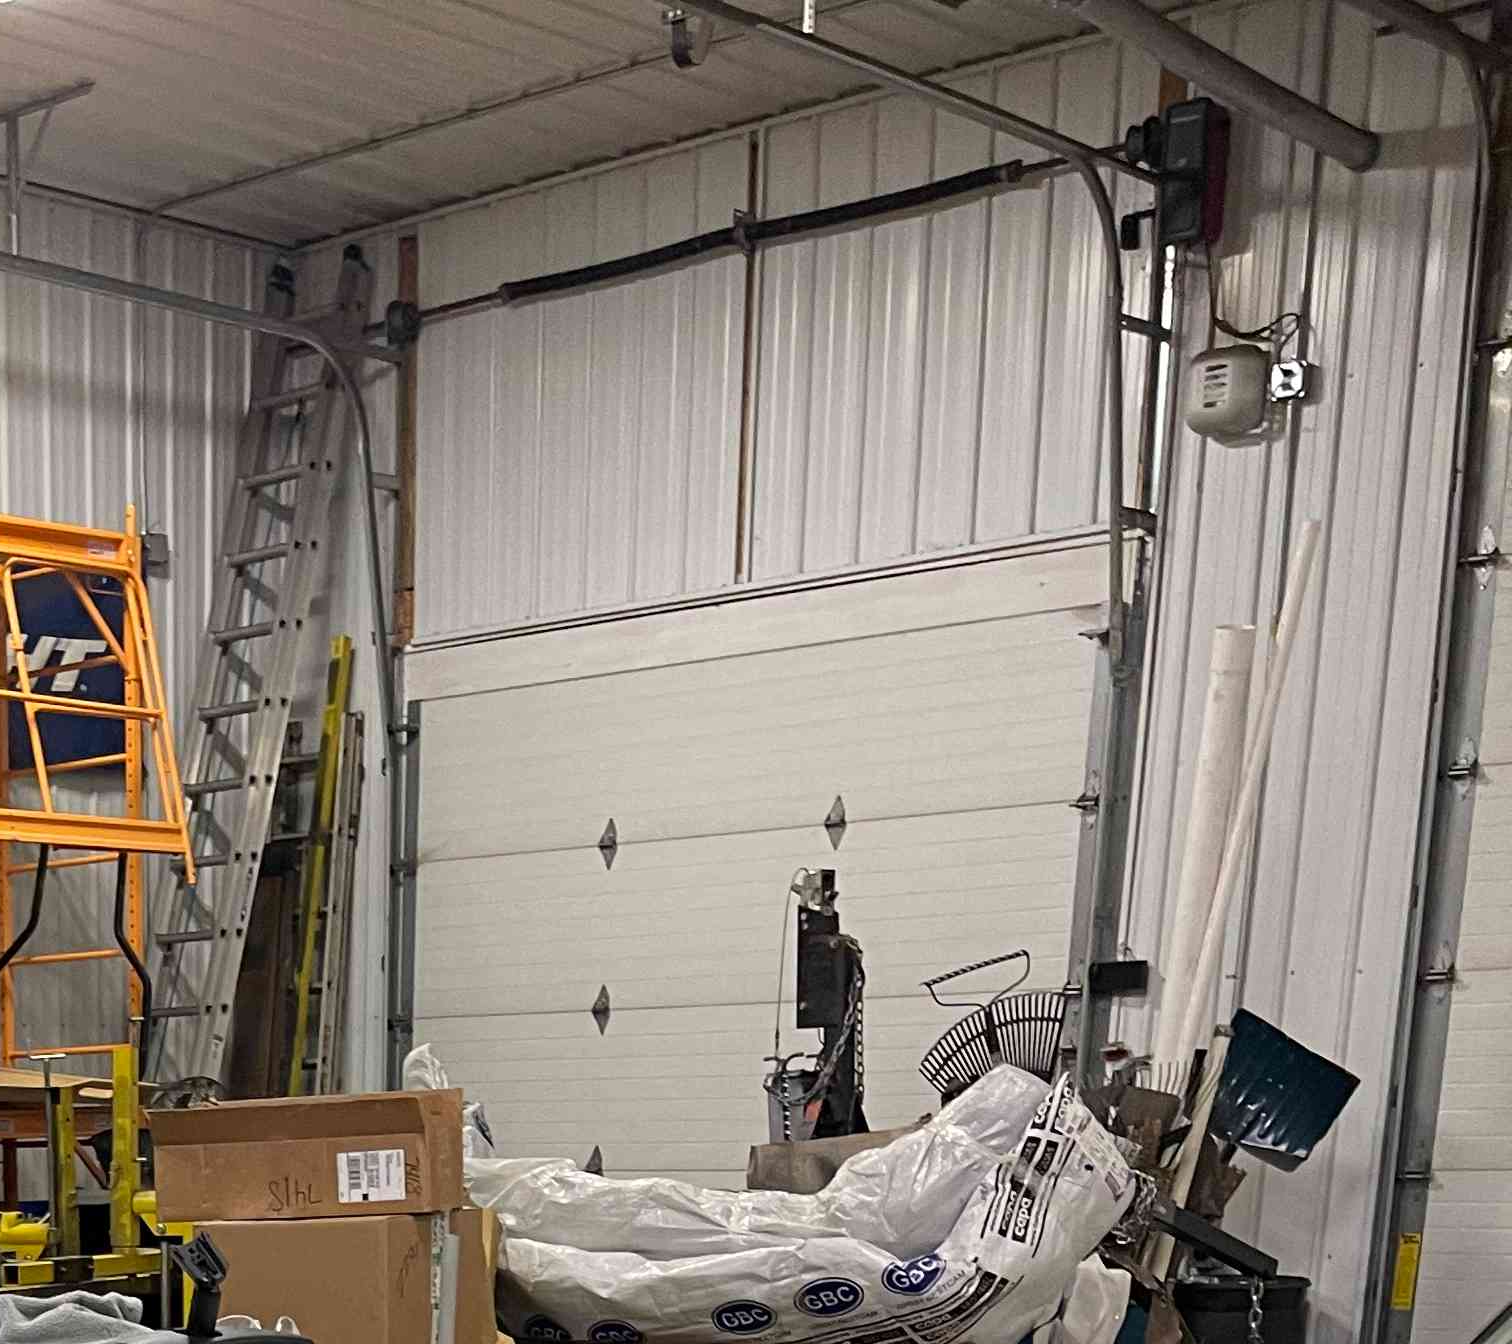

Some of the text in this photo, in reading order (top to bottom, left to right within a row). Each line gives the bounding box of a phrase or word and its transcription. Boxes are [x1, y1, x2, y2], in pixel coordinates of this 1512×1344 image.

[1014, 1197, 1031, 1237] capa
[892, 1258, 937, 1289] GBC
[804, 1285, 856, 1311] GBC
[722, 1309, 769, 1328] GBC
